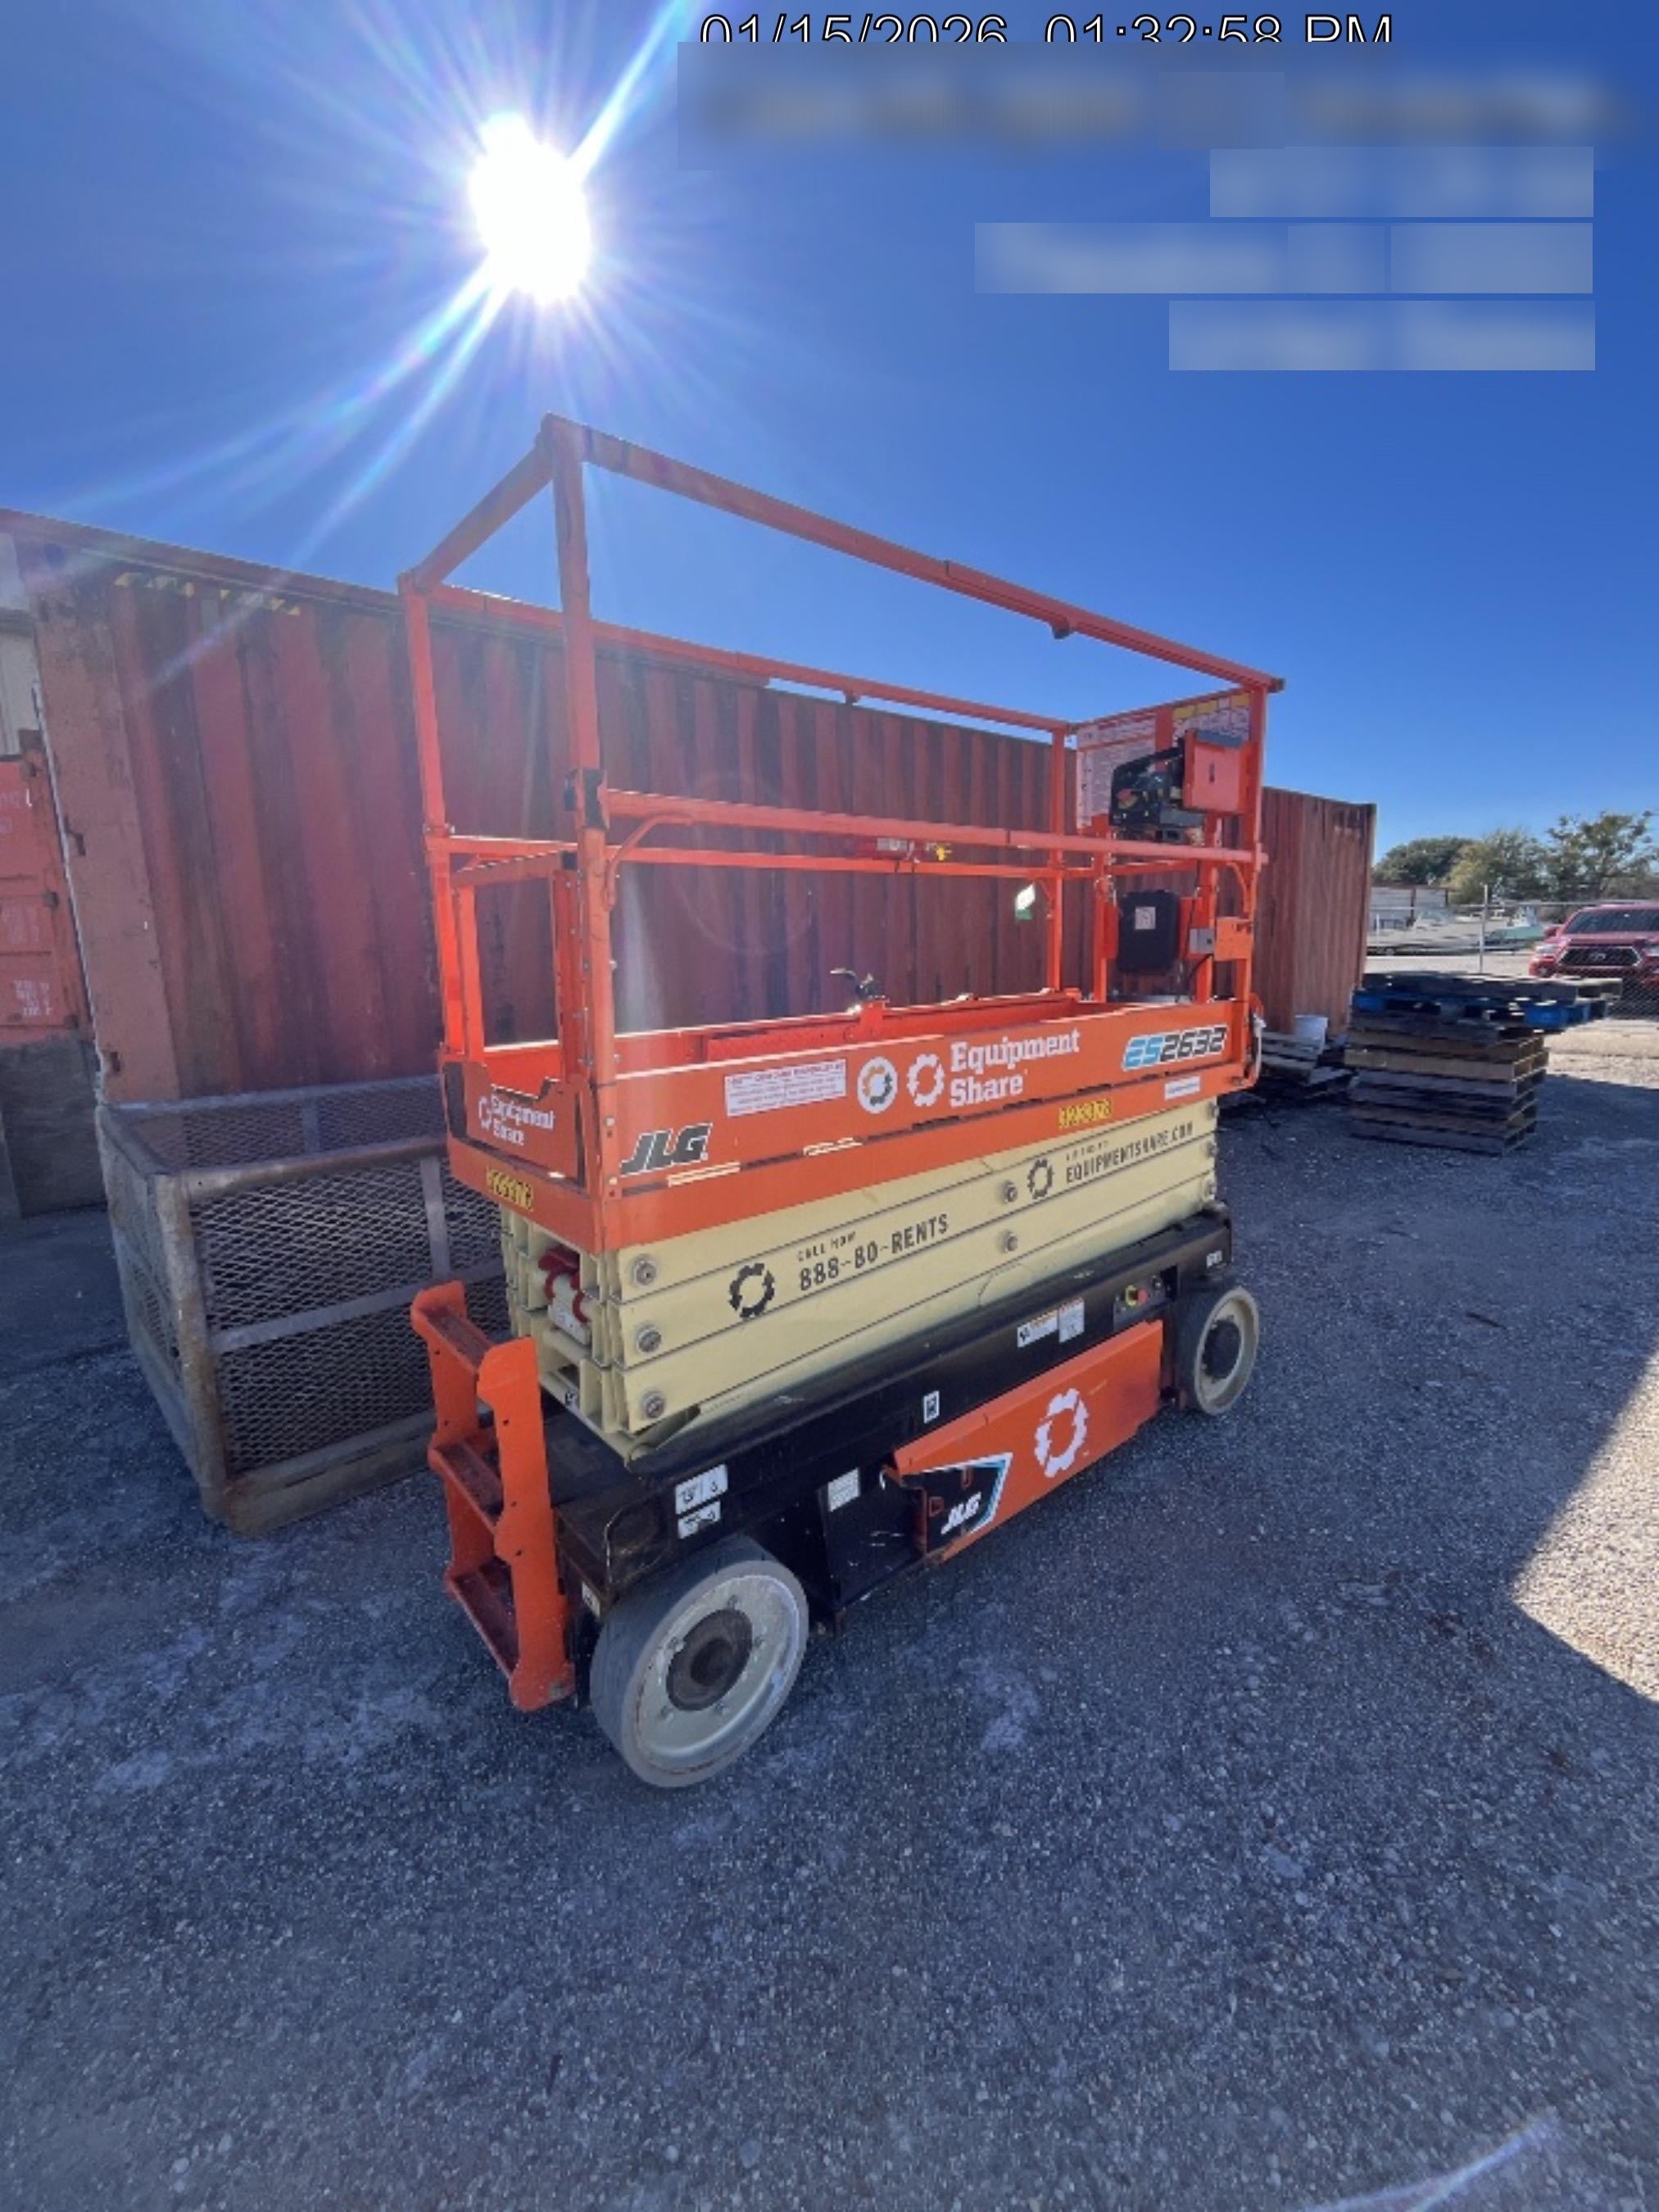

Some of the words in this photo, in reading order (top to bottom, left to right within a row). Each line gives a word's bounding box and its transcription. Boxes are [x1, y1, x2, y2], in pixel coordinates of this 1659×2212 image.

[950, 1027, 1081, 1075] Equipment
[1123, 1024, 1228, 1070] ES2632
[950, 1073, 1024, 1108] Share
[619, 1122, 714, 1177] JLG
[941, 1491, 981, 1535] JLG
